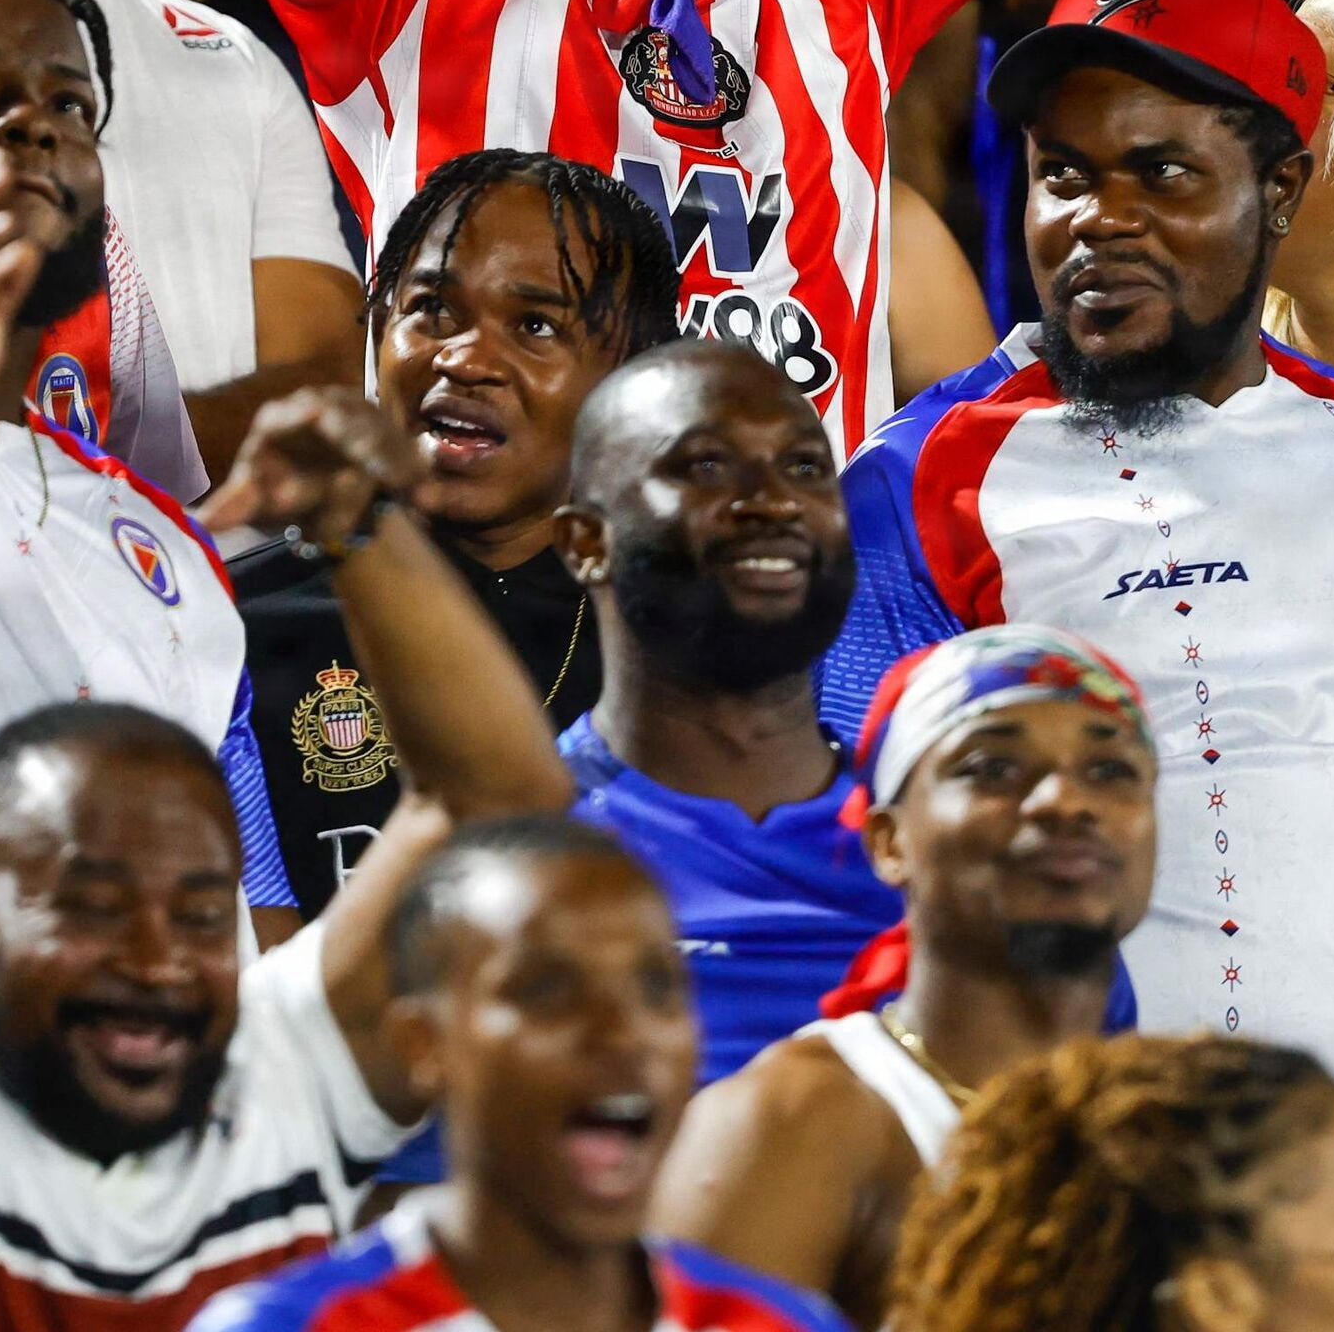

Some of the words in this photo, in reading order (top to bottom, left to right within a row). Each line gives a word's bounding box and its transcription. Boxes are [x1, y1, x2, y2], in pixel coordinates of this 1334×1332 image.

[652, 97, 697, 117] SUNDERLAND
[53, 377, 73, 387] HAITI
[1102, 561, 1249, 601] SAETA
